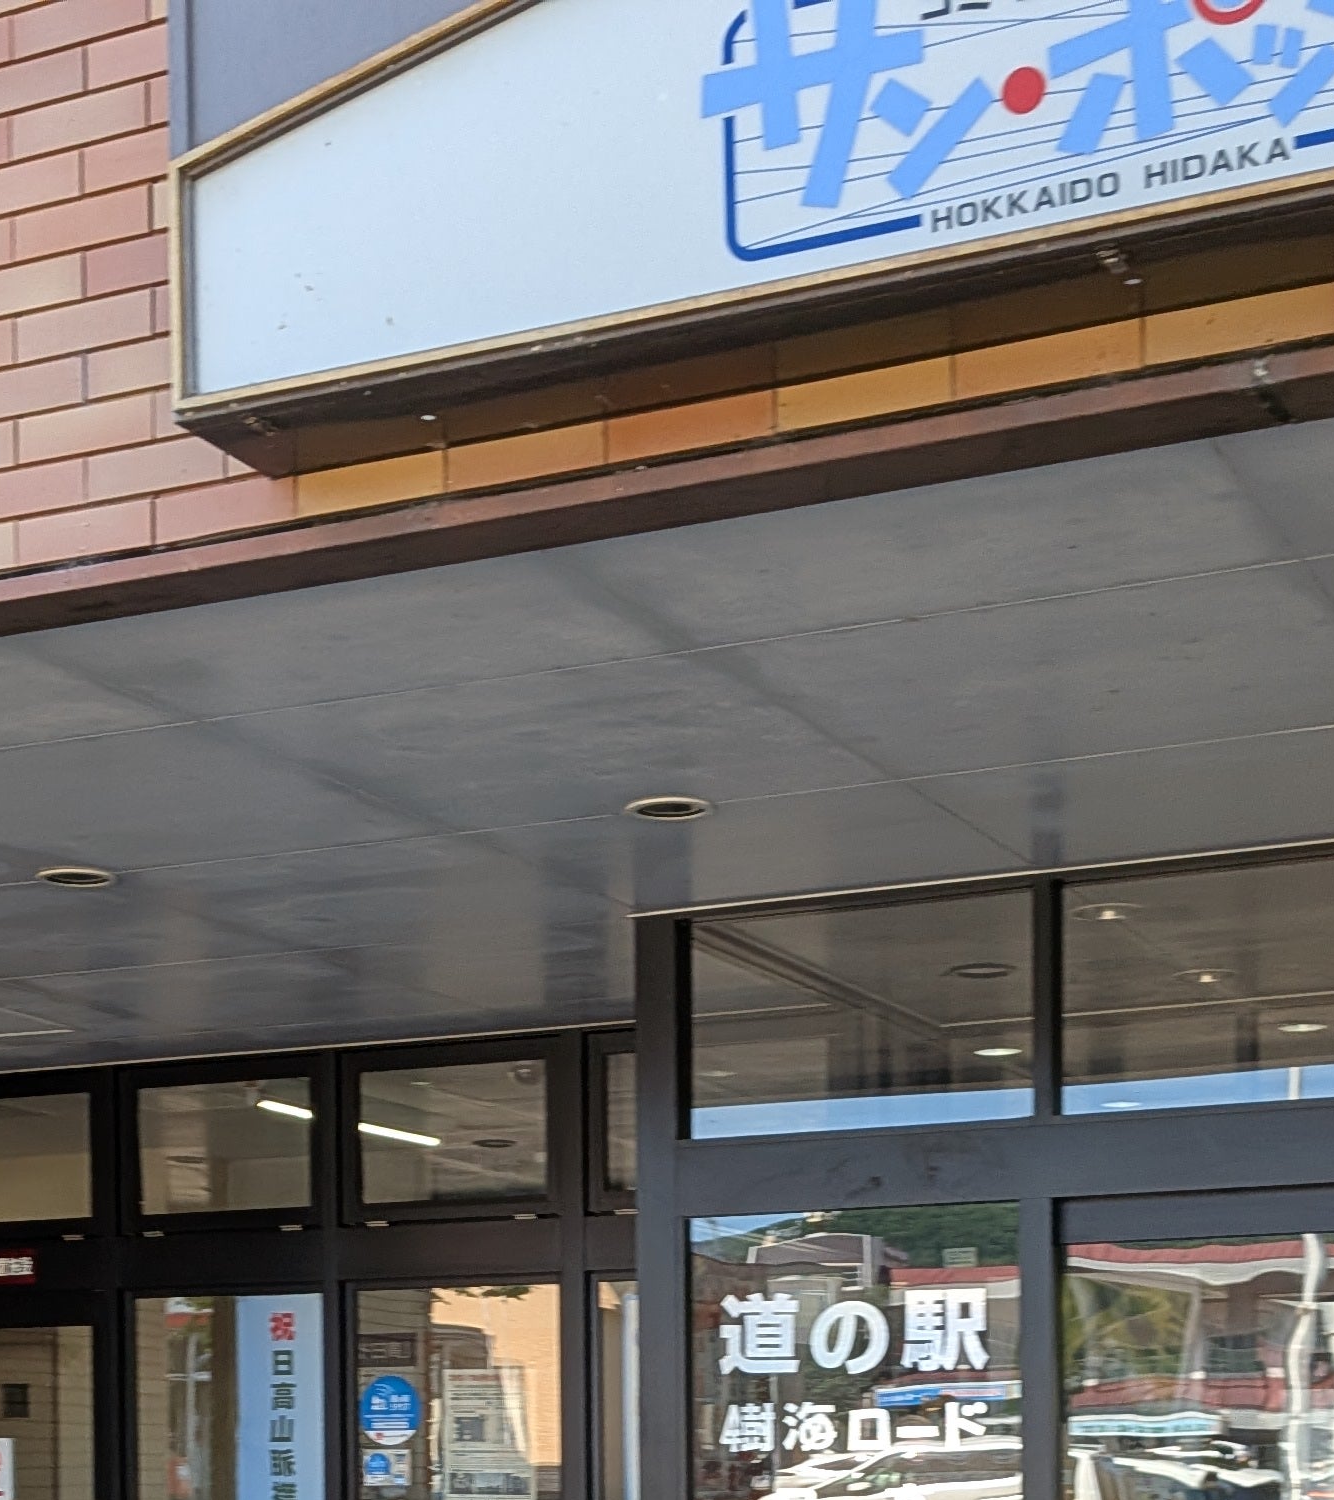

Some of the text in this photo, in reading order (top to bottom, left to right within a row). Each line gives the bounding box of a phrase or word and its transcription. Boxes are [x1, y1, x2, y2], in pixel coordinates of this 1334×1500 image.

[928, 137, 1294, 234] HOKKAIDO HIDAKA
[718, 1287, 991, 1375] 道の駅
[719, 1401, 989, 1453] 樹海ロード
